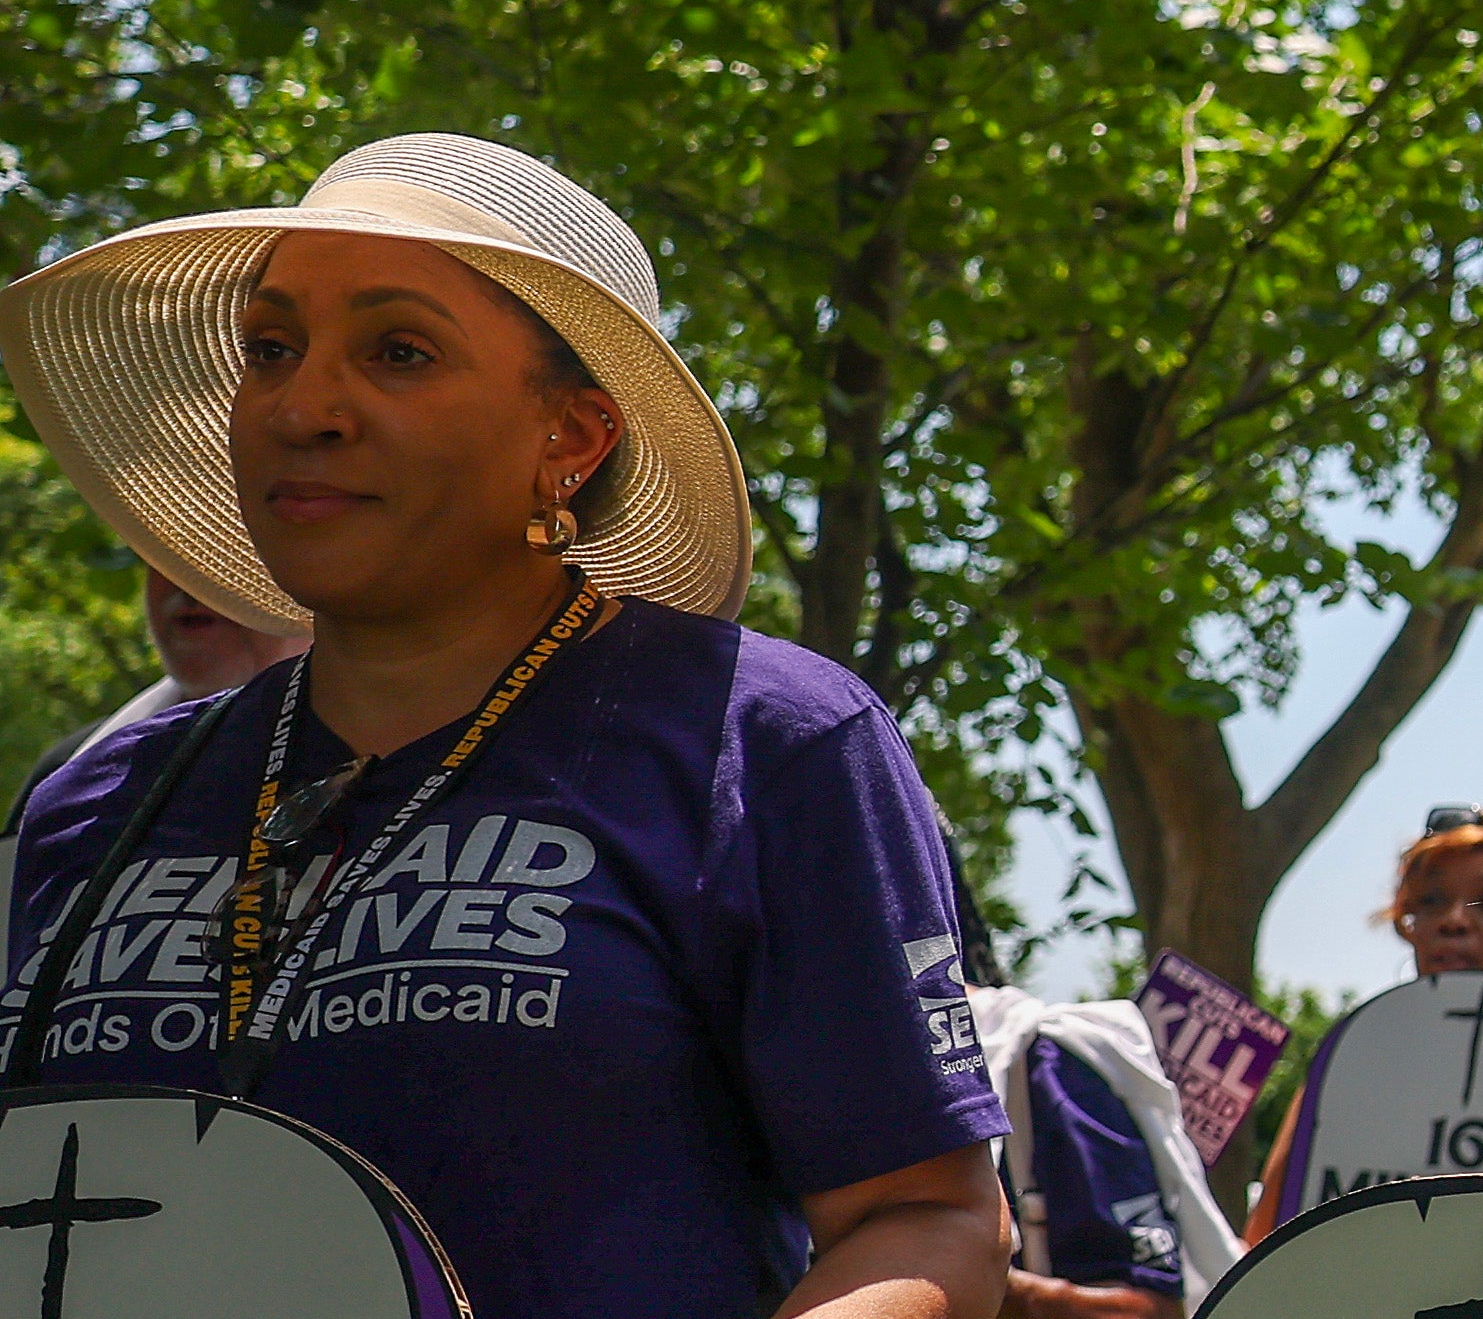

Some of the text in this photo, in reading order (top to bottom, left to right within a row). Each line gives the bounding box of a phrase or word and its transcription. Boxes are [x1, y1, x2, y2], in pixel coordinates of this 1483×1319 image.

[441, 638, 561, 768] REPUBLICAN
[248, 912, 331, 1041] MEDICAID
[940, 1052, 985, 1076] Stronger
[1139, 987, 1257, 1102] KILL
